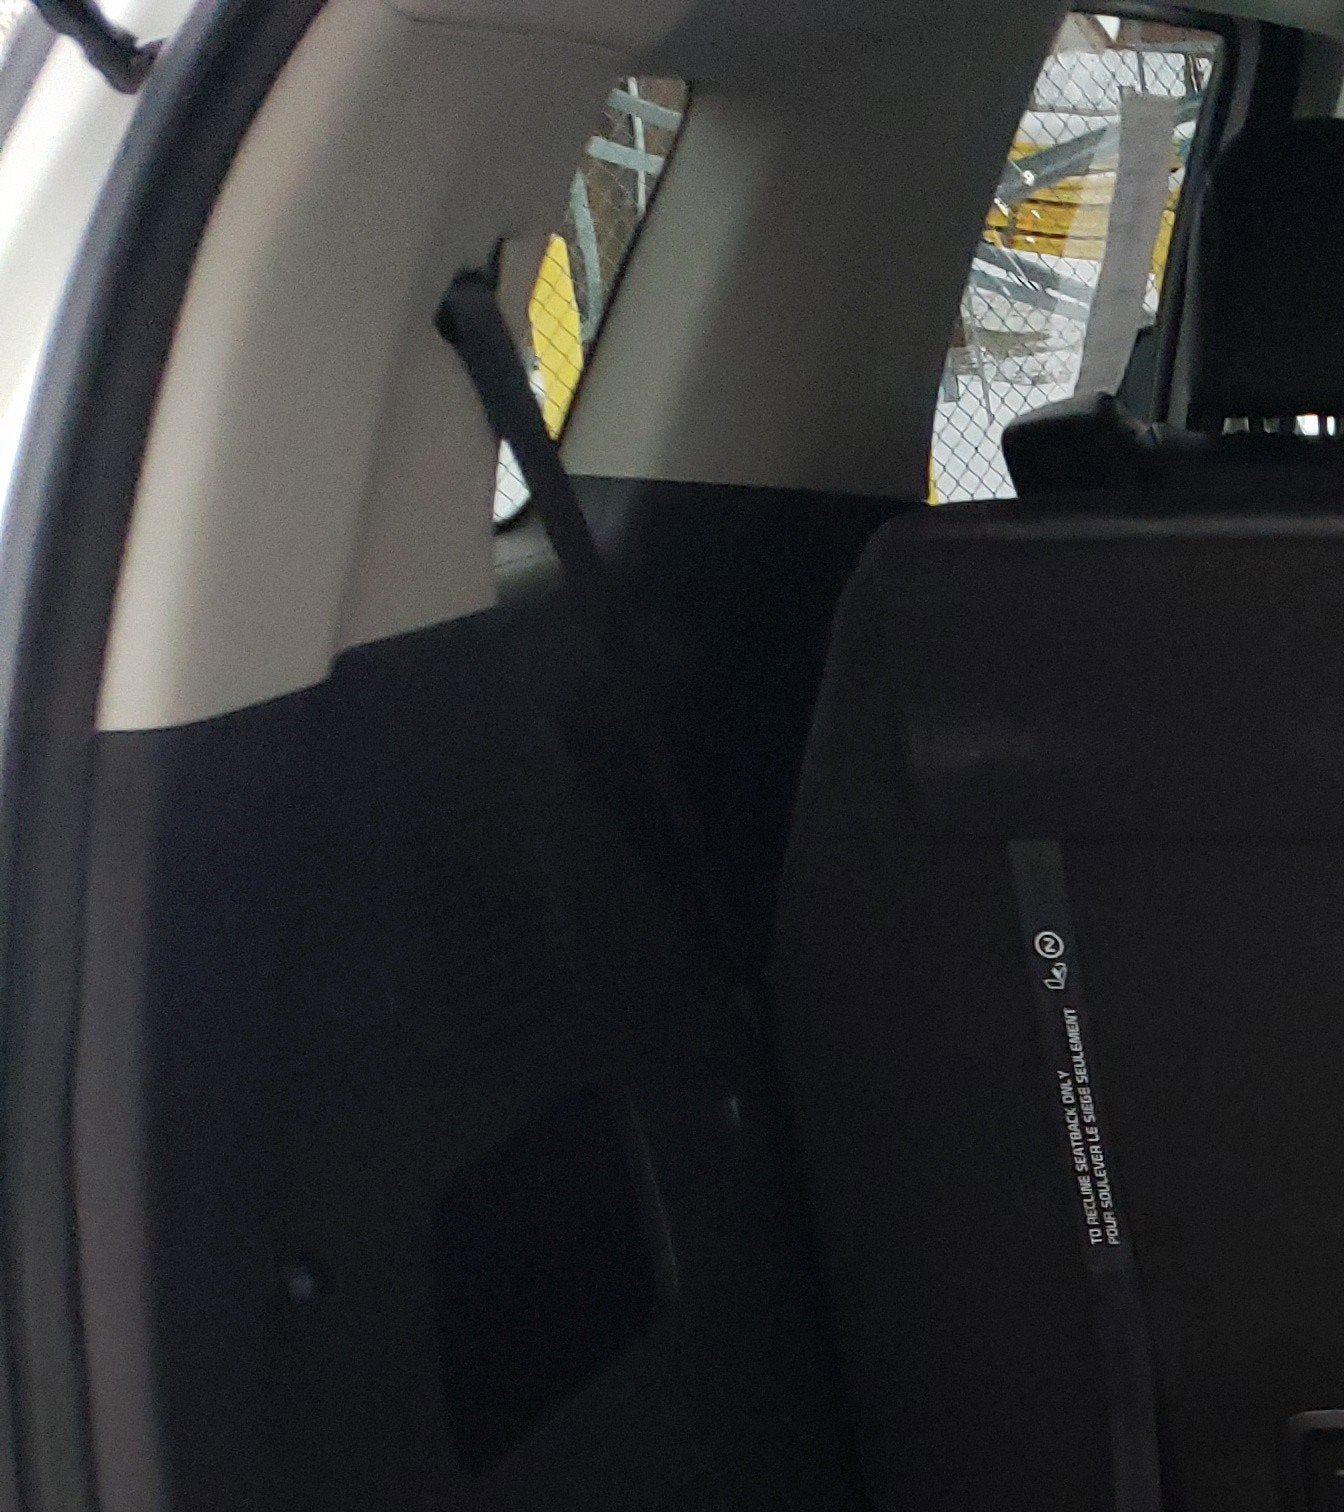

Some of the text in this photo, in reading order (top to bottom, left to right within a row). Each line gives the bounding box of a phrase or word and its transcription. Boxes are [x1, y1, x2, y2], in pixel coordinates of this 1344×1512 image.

[1063, 1007, 1089, 1084] SEULEMENT
[1057, 1070, 1102, 1245] TO RECLINE SEATBACK ONLY
[1085, 1126, 1100, 1141] LE
[1089, 1145, 1113, 1208] SOULEVER
[1103, 1211, 1121, 1245] POUR
